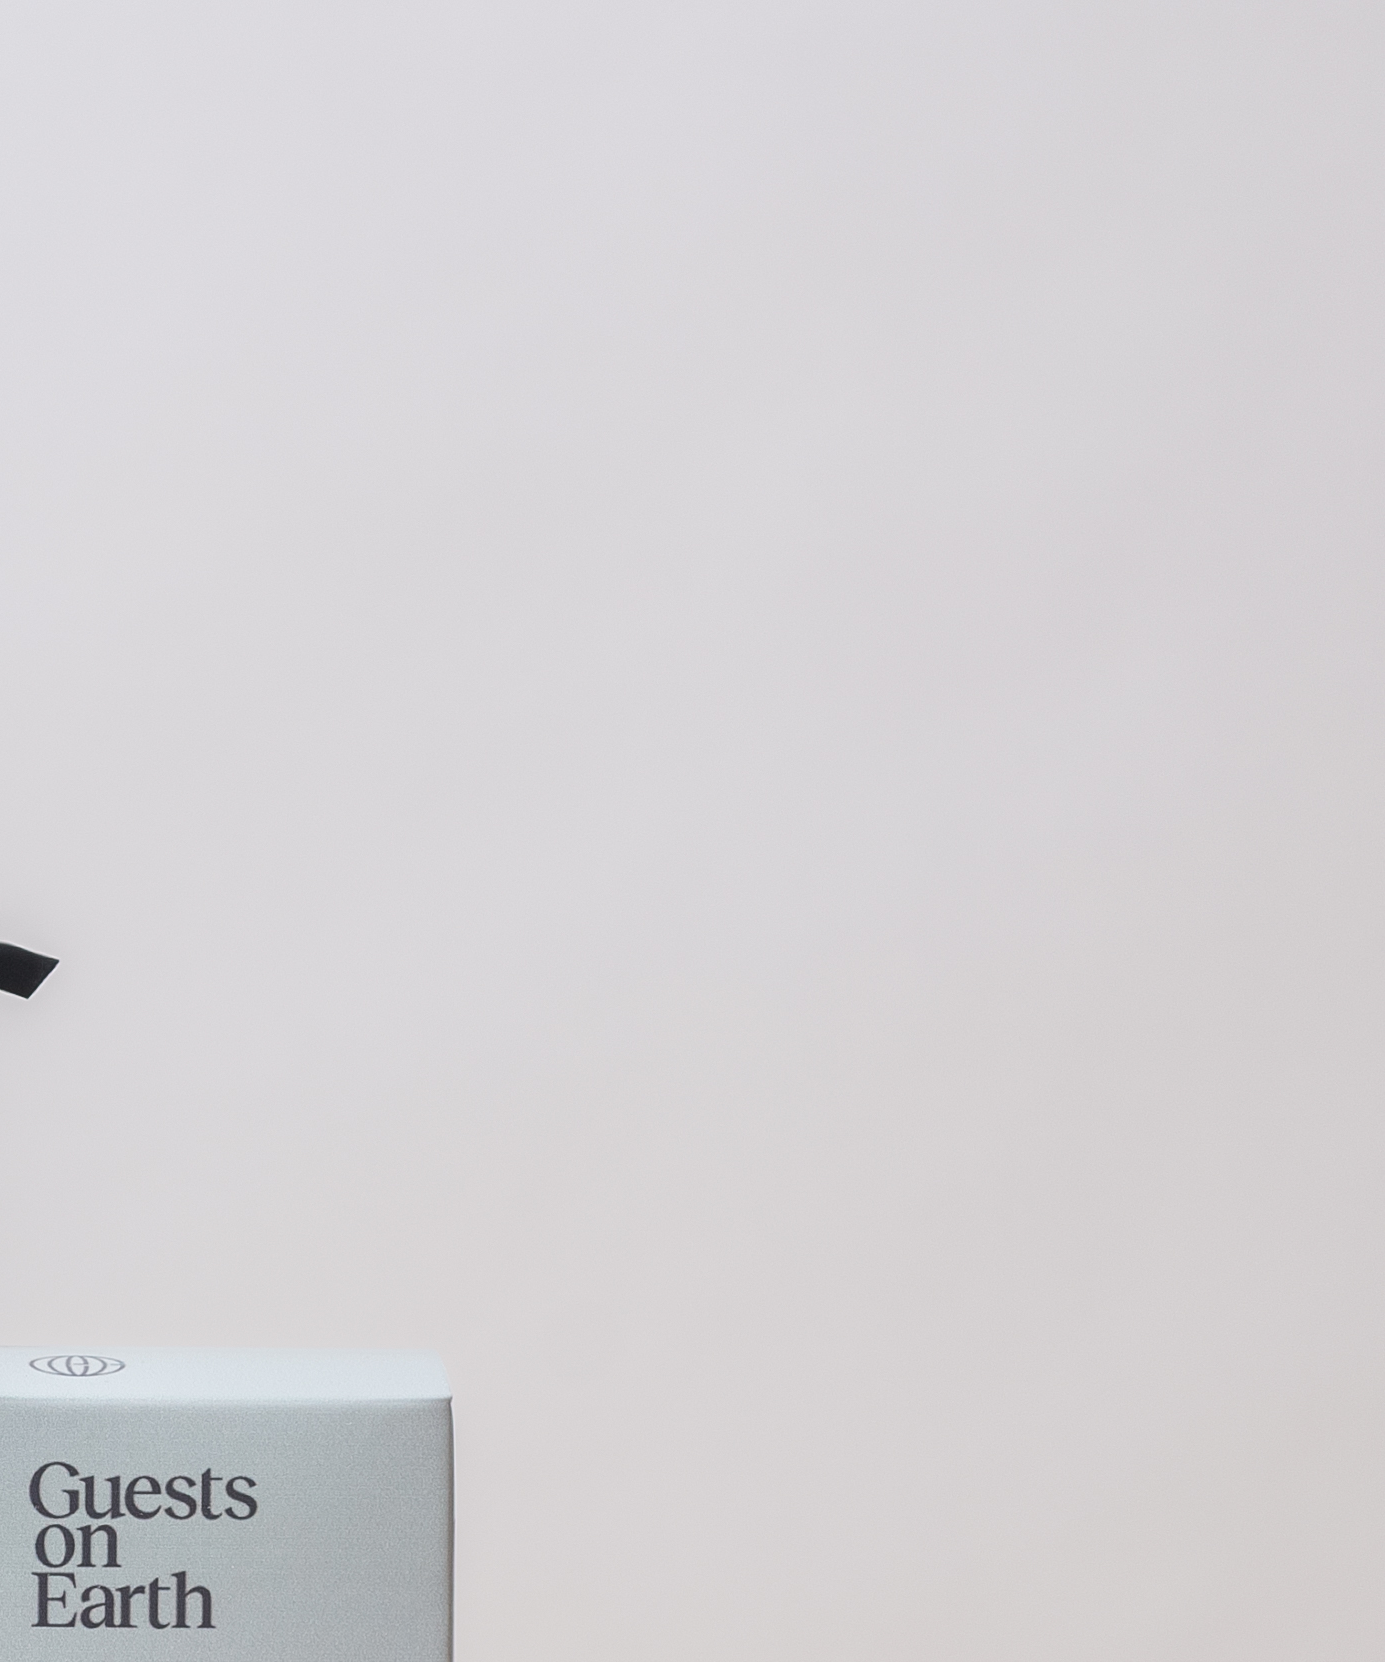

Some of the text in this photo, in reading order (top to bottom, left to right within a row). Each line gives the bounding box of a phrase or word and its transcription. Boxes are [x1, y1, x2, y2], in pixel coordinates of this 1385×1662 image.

[28, 1461, 258, 1521] Guests
[34, 1523, 122, 1569] on
[31, 1570, 217, 1630] Earth
